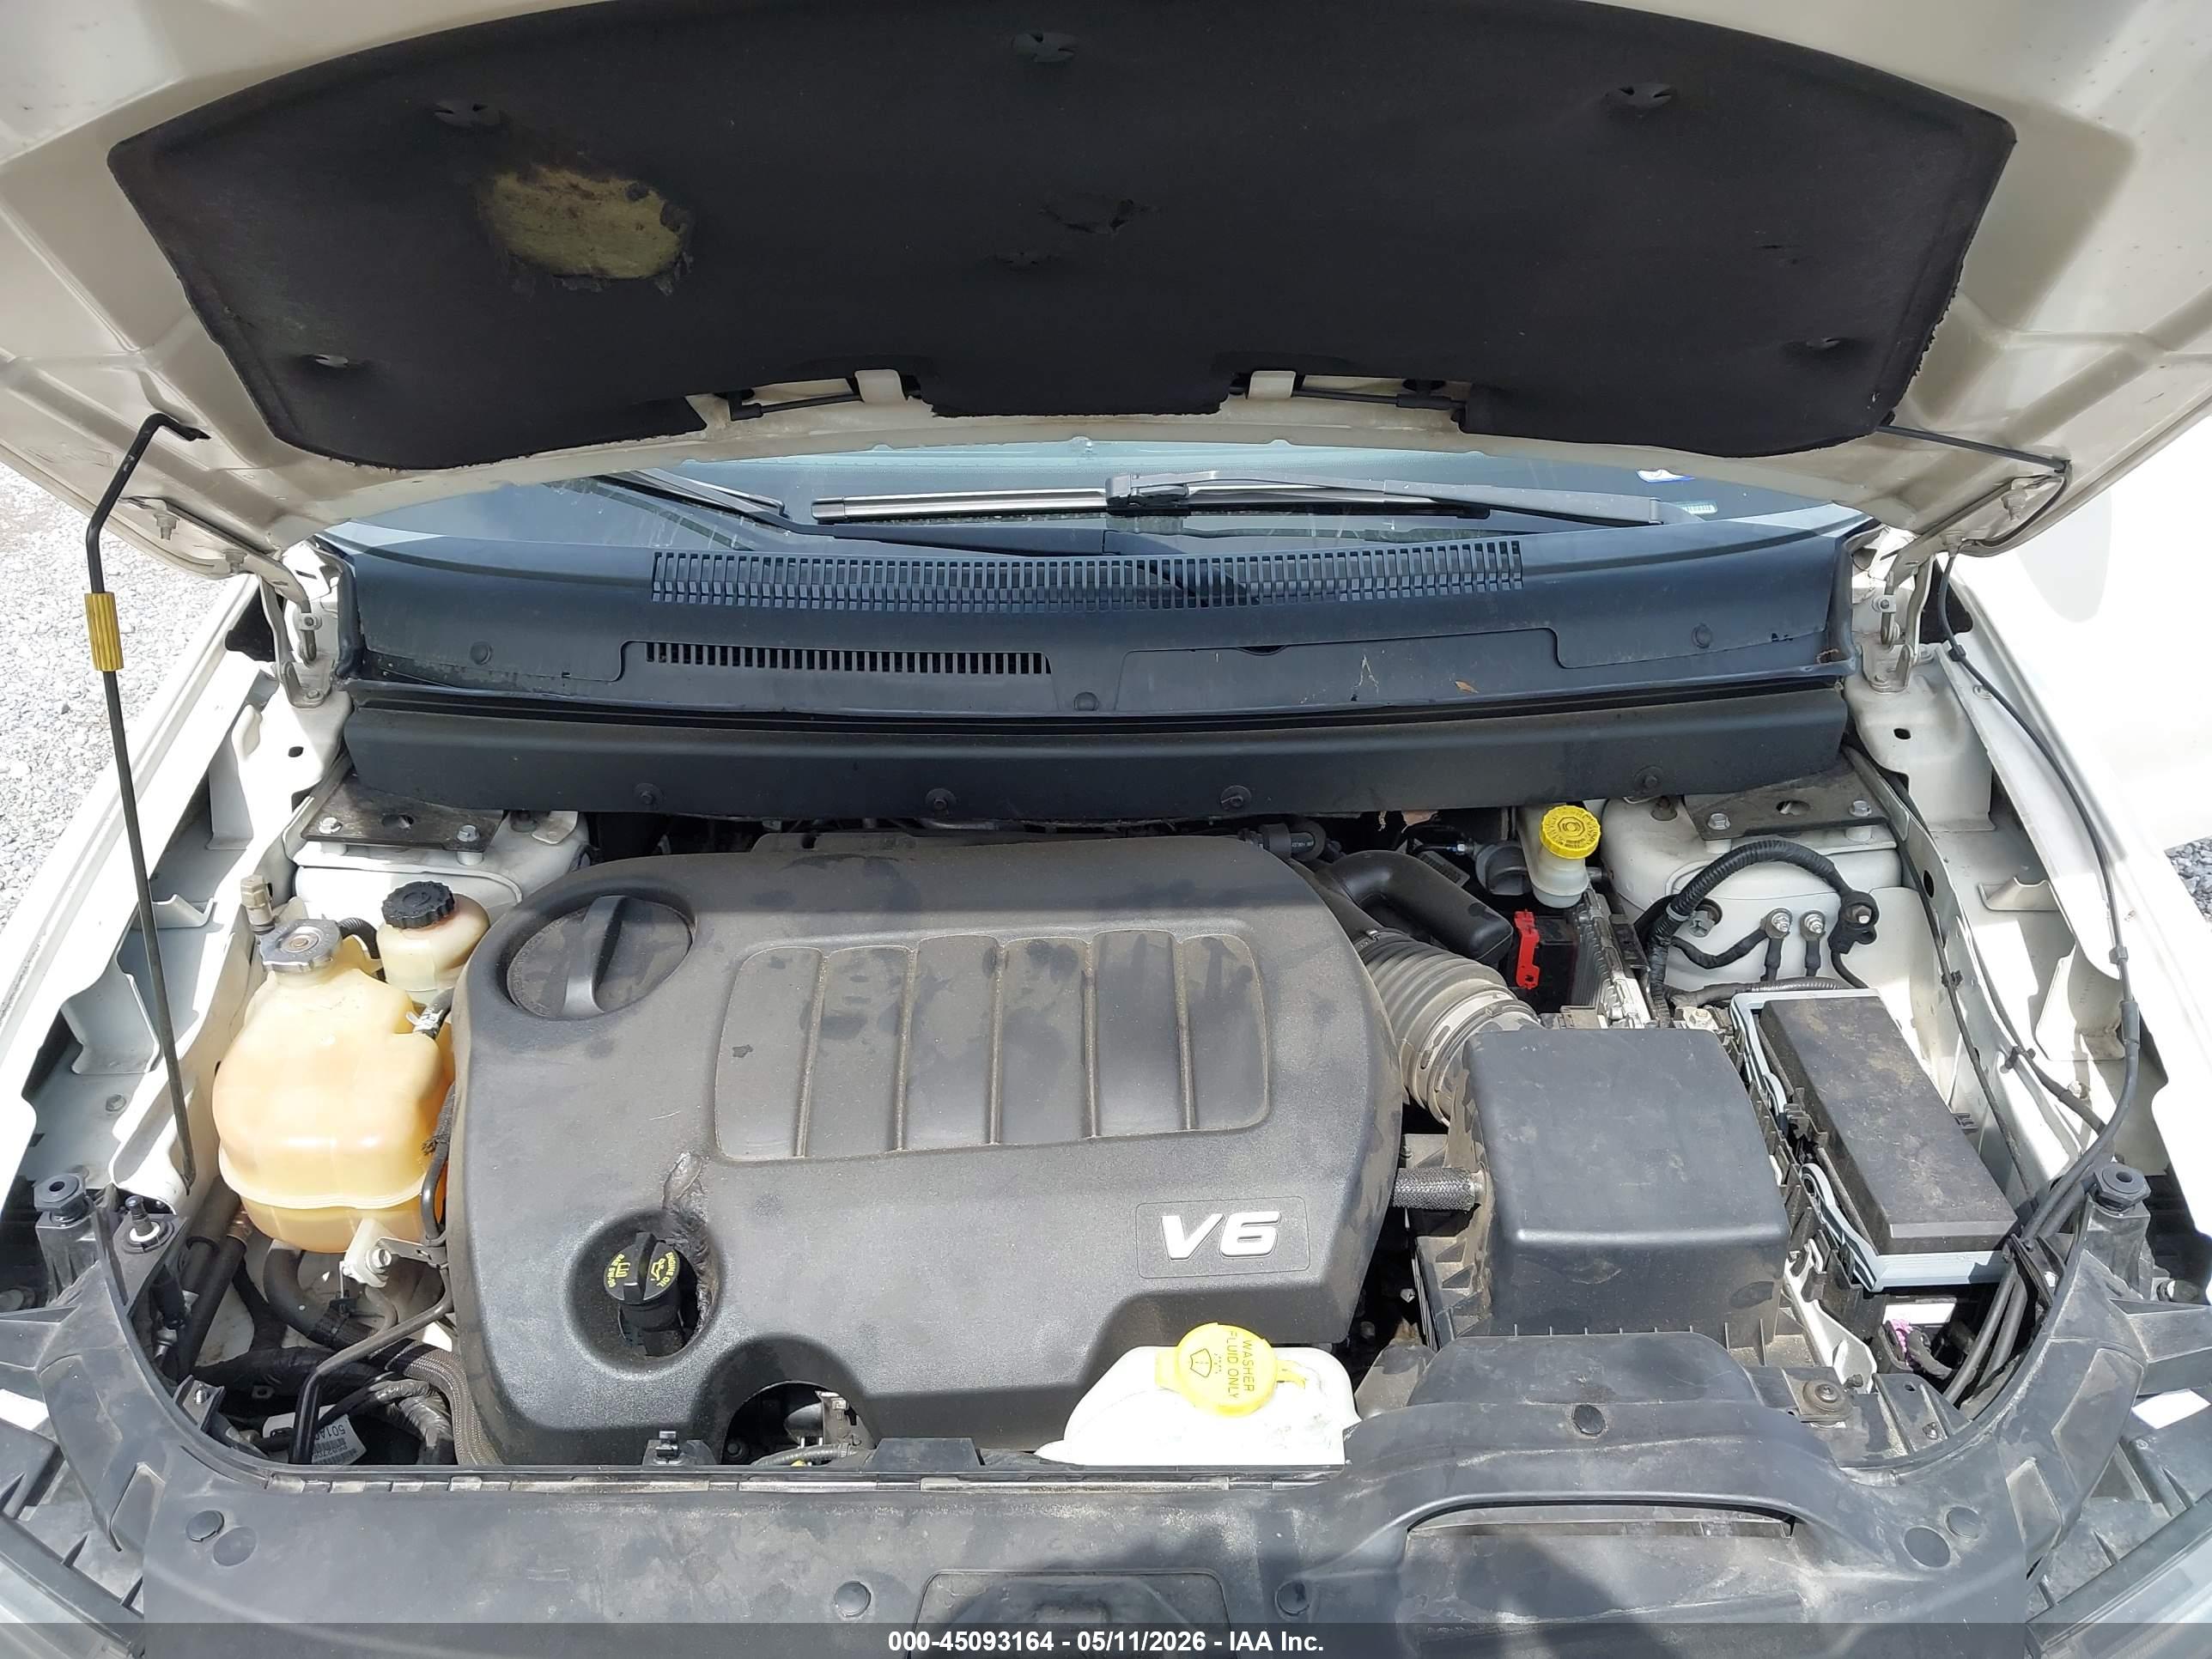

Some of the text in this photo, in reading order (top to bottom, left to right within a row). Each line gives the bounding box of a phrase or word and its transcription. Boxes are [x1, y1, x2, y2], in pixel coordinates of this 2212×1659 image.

[1161, 1211, 1281, 1261] V6
[656, 1251, 676, 1287] ENGINE OIL
[1226, 1330, 1239, 1399] FLUID ONLY
[1243, 1340, 1255, 1392] WASHER
